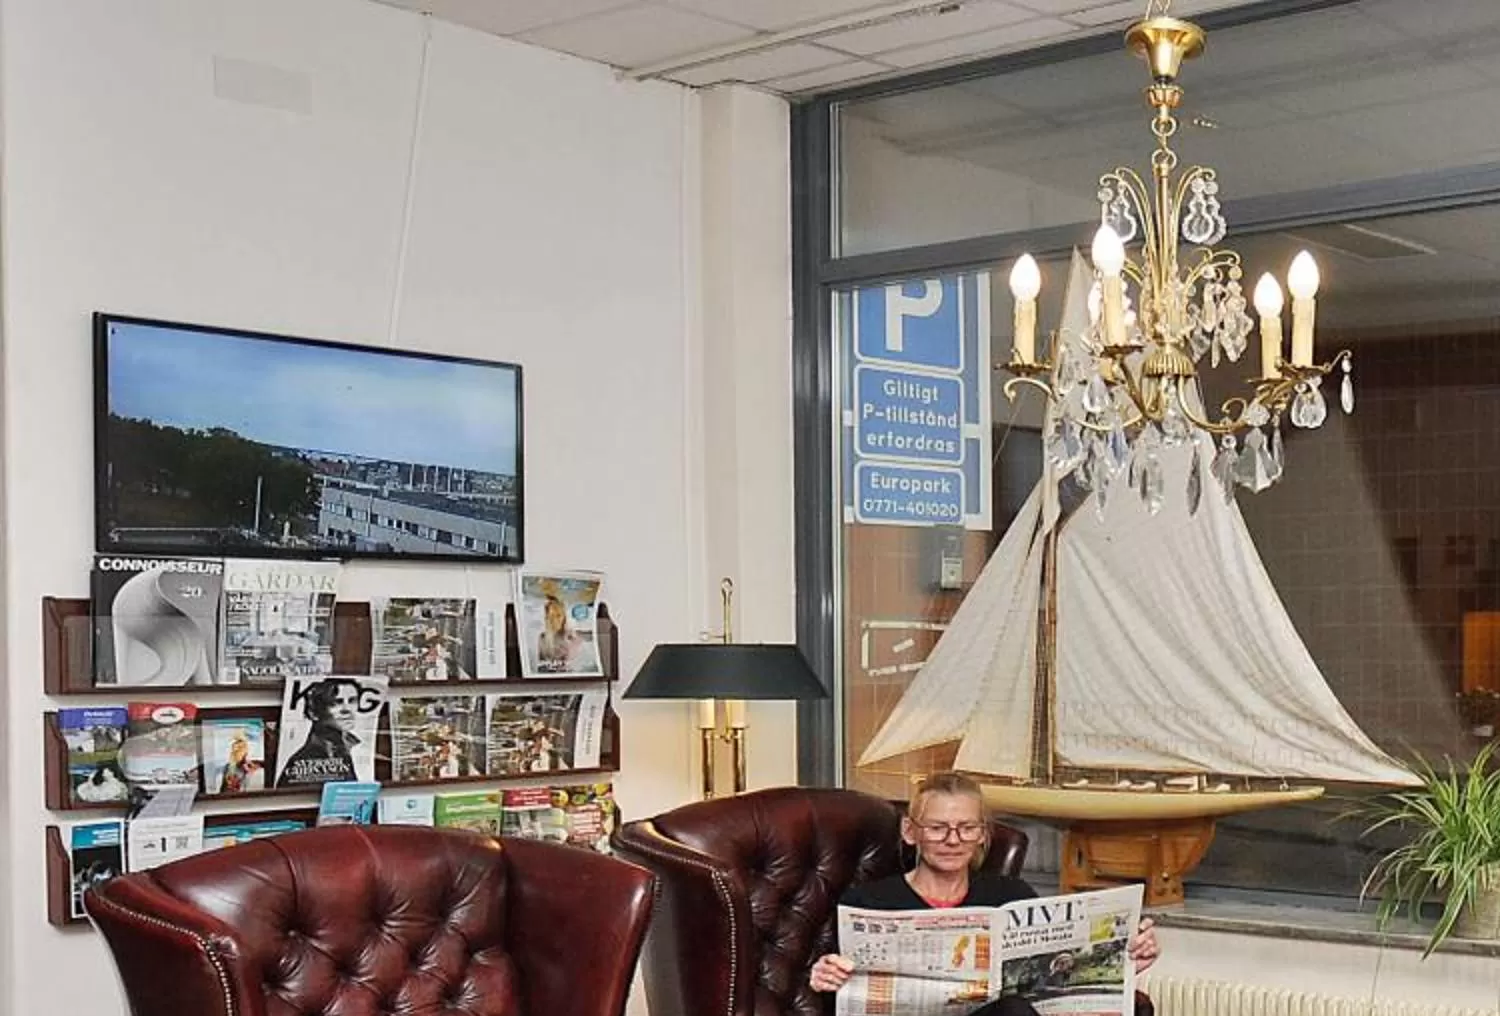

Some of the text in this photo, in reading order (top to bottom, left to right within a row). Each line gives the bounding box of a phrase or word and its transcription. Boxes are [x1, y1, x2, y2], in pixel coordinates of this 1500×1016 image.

[885, 279, 943, 352] P
[883, 379, 939, 404] Giltigt
[863, 403, 957, 429] P-tillstånd
[866, 431, 956, 453] erfordras
[870, 471, 951, 494] Europark
[99, 557, 223, 575] CONNOISSEUR
[290, 680, 382, 713] KG
